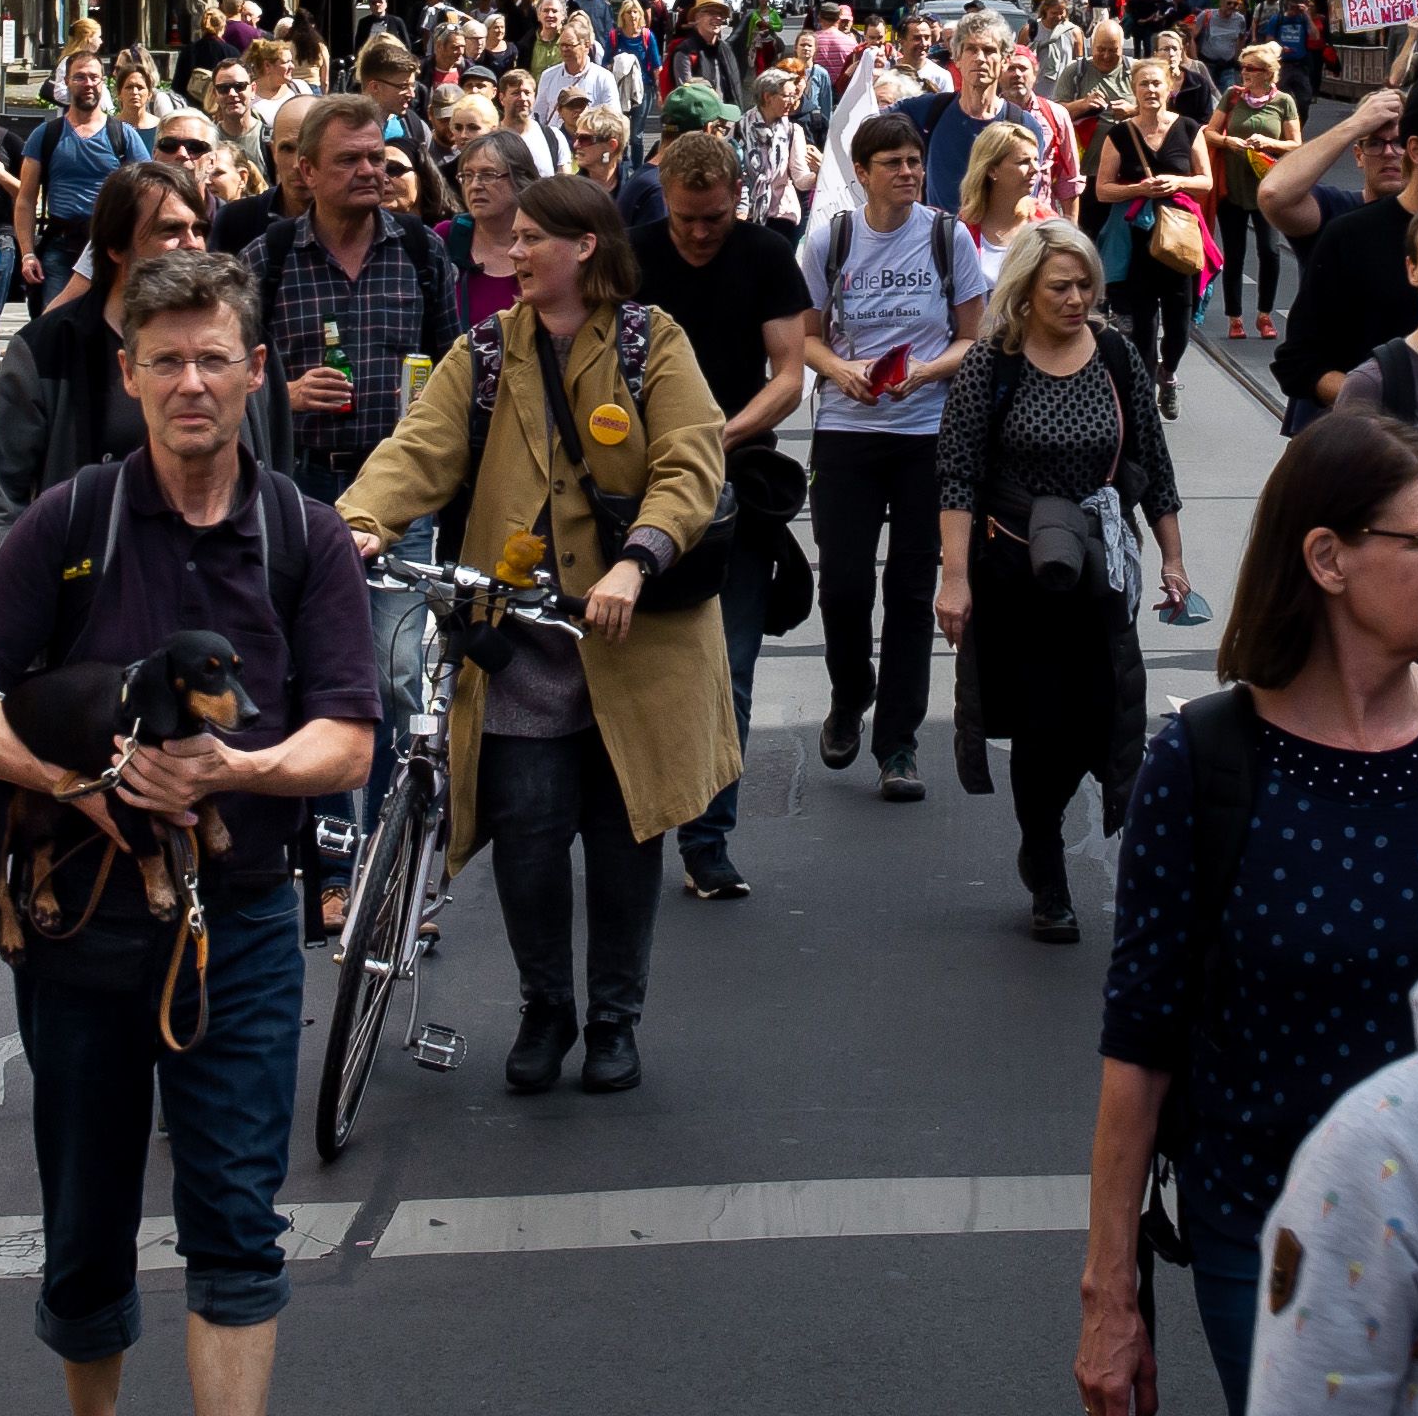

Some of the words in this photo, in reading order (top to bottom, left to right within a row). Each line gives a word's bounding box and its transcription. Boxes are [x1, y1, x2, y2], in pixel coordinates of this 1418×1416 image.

[1347, 2, 1369, 17] DA
[1349, 14, 1378, 32] MAL
[1380, 8, 1415, 28] NEIN
[857, 310, 876, 320] bist
[879, 308, 894, 318] die
[896, 307, 921, 317] Basis
